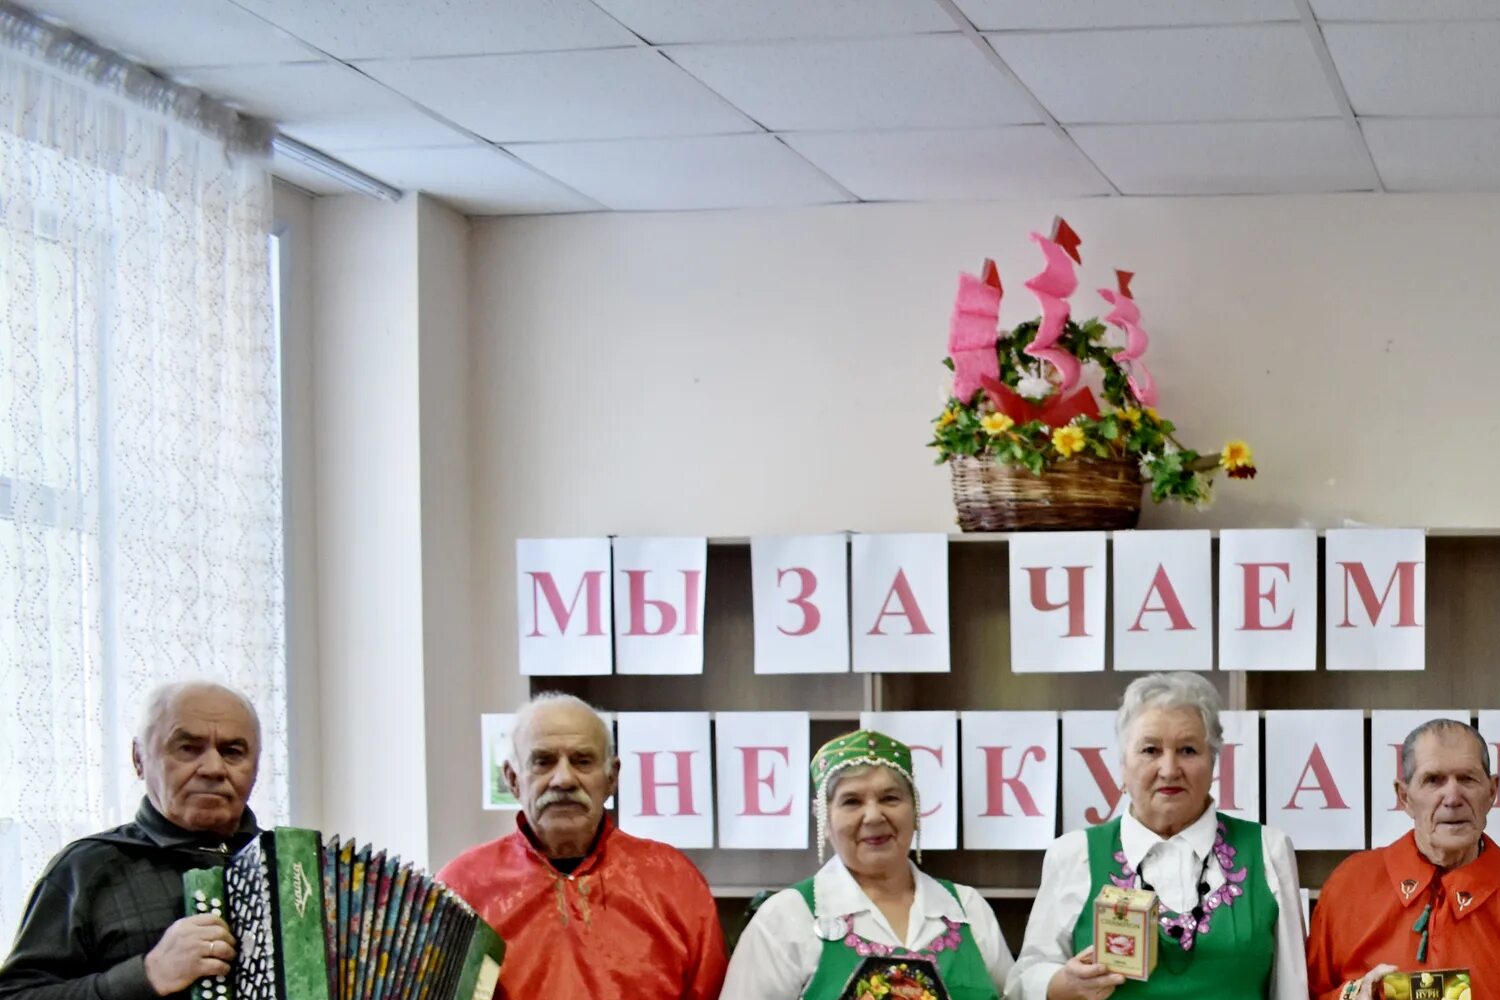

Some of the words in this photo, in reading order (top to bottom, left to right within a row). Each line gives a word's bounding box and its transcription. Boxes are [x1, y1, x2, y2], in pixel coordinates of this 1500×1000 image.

[525, 568, 701, 637] МЫ
[776, 566, 935, 637] ЗА
[1020, 561, 1425, 638] ЧАЕМ
[631, 745, 795, 818] НЕ
